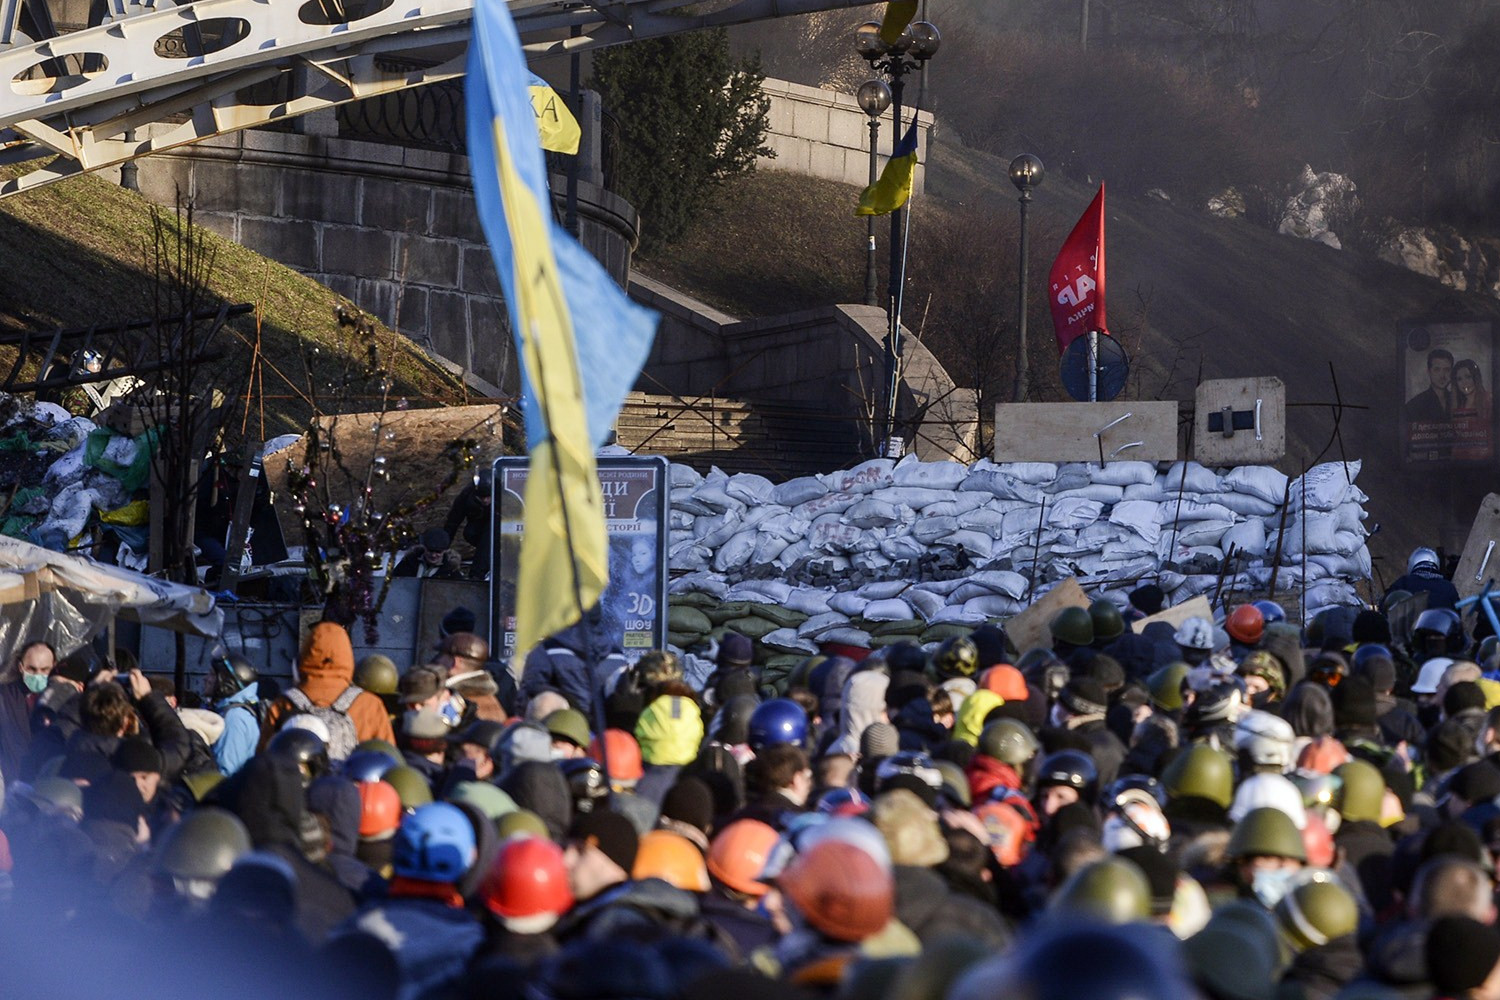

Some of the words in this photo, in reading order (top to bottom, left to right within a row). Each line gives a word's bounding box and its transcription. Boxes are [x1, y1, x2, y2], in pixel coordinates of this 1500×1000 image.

[606, 523, 642, 532] СТОРІЇ
[626, 592, 653, 616] 3D
[624, 619, 652, 630] ШОУ
